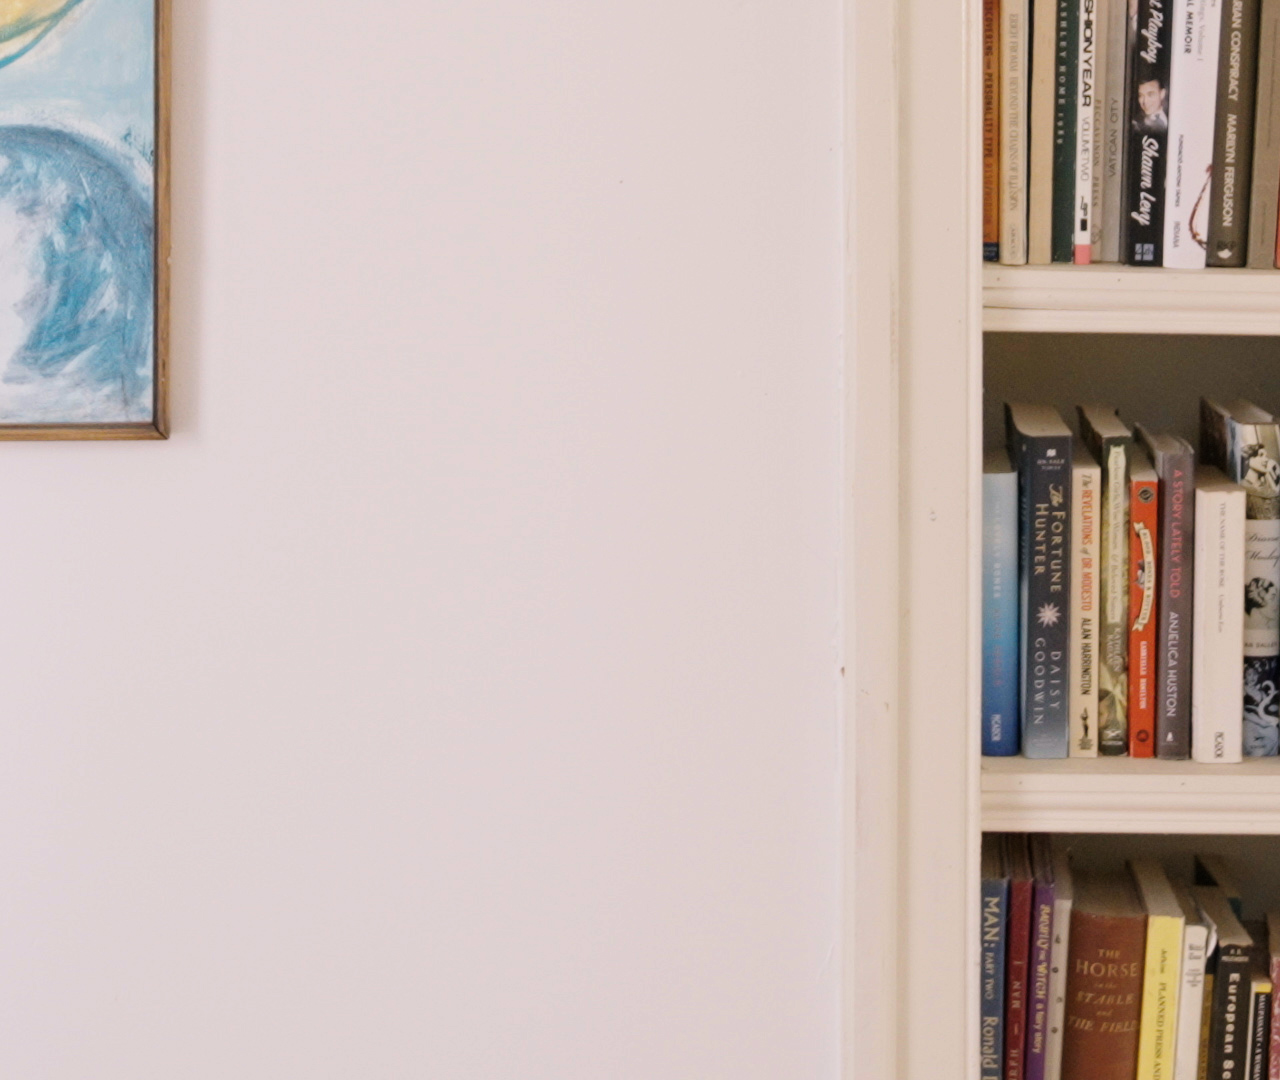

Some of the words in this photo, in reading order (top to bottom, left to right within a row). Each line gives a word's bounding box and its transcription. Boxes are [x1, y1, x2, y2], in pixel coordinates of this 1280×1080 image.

[1144, 10, 1163, 63] Playboy
[1184, 11, 1194, 54] MEMOIR
[1081, 55, 1093, 107] YEAR
[1227, 31, 1242, 102] CONSPIRACY
[1140, 135, 1159, 188] Shawn
[1225, 114, 1237, 163] MARILYN
[1131, 190, 1155, 225] Levy
[1223, 167, 1235, 227] FERGUSON
[1049, 484, 1065, 507] The
[1173, 469, 1182, 478] A
[1171, 480, 1182, 520] STORY
[1034, 503, 1050, 575] HUNTER
[1050, 511, 1065, 592] FORTUNE
[1170, 522, 1182, 563] LATELY
[1170, 567, 1180, 598] TOLD
[1080, 617, 1092, 640] ALAN
[1167, 611, 1179, 666] ANJELICA
[1033, 638, 1046, 725] GOODWIN
[1049, 651, 1062, 709] DAISY
[1080, 643, 1092, 695] HARRINGTON
[1166, 669, 1177, 717] HUSTON
[984, 897, 1000, 948] MAN:
[984, 952, 994, 974] PART
[1076, 959, 1138, 977] HORSE
[1097, 949, 1120, 959] THE
[984, 979, 994, 1000] TWO
[1225, 973, 1240, 1054] European
[1256, 994, 1267, 1041] MAUPASSANT
[983, 1016, 998, 1069] Ronald
